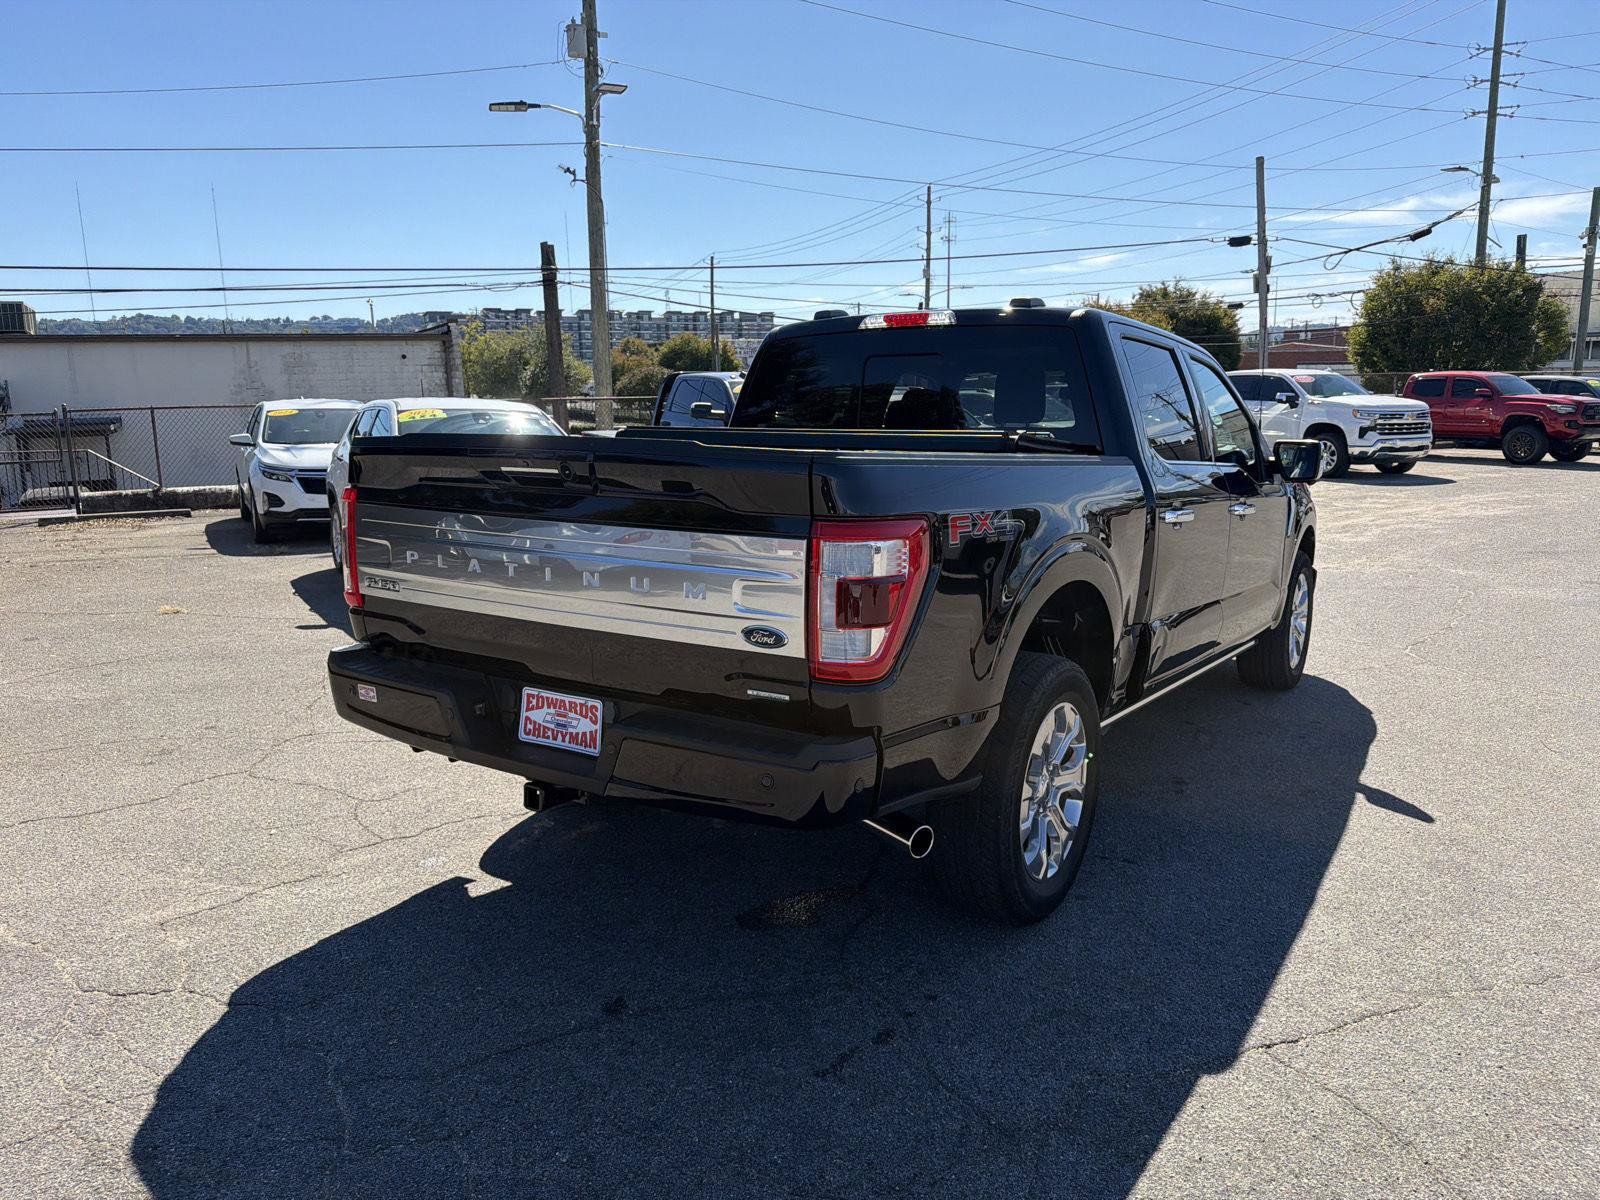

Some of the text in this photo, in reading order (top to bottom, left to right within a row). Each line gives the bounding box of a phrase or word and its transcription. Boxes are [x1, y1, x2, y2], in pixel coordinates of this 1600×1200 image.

[948, 511, 1014, 547] FX4
[406, 551, 707, 601] PLATINUM
[750, 629, 776, 645] Ford
[526, 692, 599, 726] EDWARDS
[523, 715, 599, 751] CHEVYMAN
